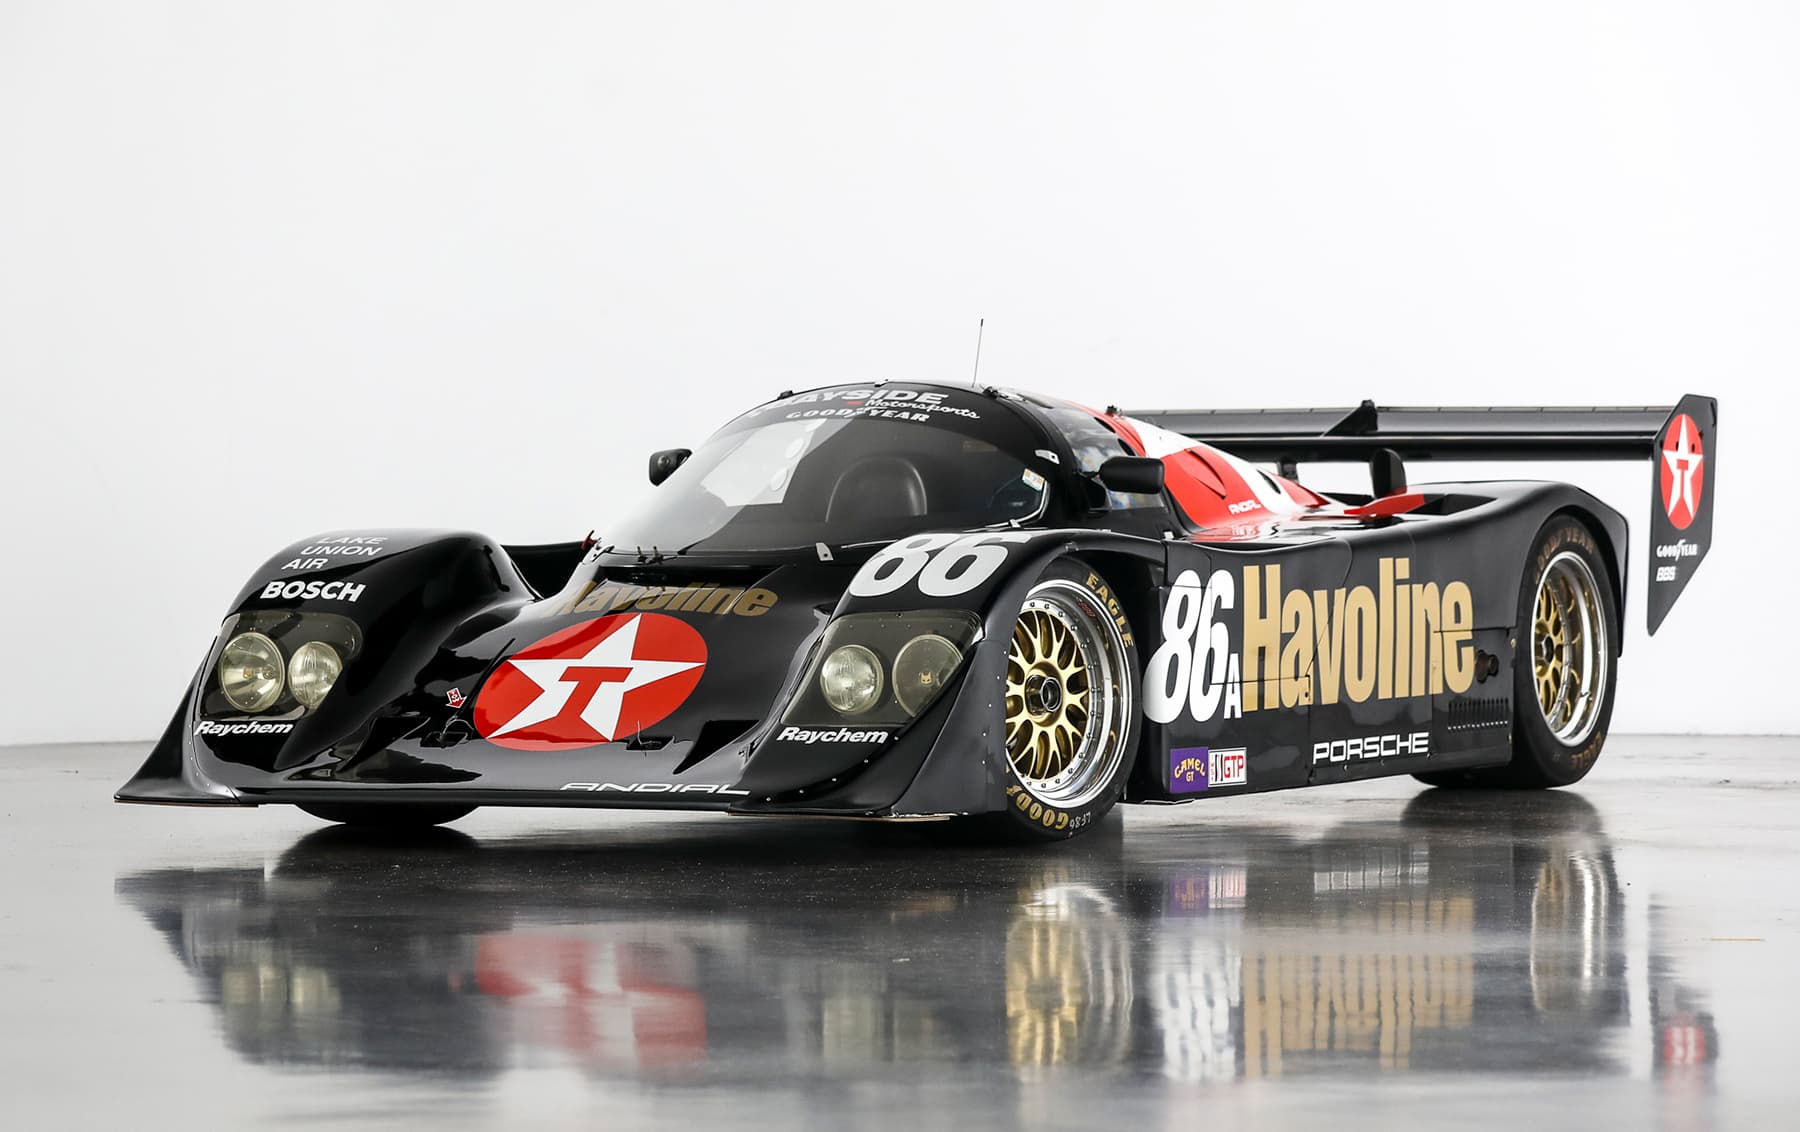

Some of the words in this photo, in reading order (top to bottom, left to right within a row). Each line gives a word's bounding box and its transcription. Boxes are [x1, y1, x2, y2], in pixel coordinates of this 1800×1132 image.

[864, 399, 980, 419] Motorsports
[300, 545, 383, 556] UNION
[316, 536, 389, 545] LAKE
[281, 558, 329, 570] AIR
[849, 532, 1033, 598] 86
[259, 581, 366, 603] BOSCH
[1086, 572, 1135, 648] EAGLE
[1242, 557, 1475, 713] Havoline
[193, 720, 294, 737] Raychem
[776, 725, 889, 745] Raychem
[1312, 732, 1430, 765] PORSCHE
[1174, 757, 1206, 779] CAMEL
[1185, 770, 1195, 782] GT
[1223, 754, 1245, 779] GTP
[559, 781, 751, 796] ANDIAL
